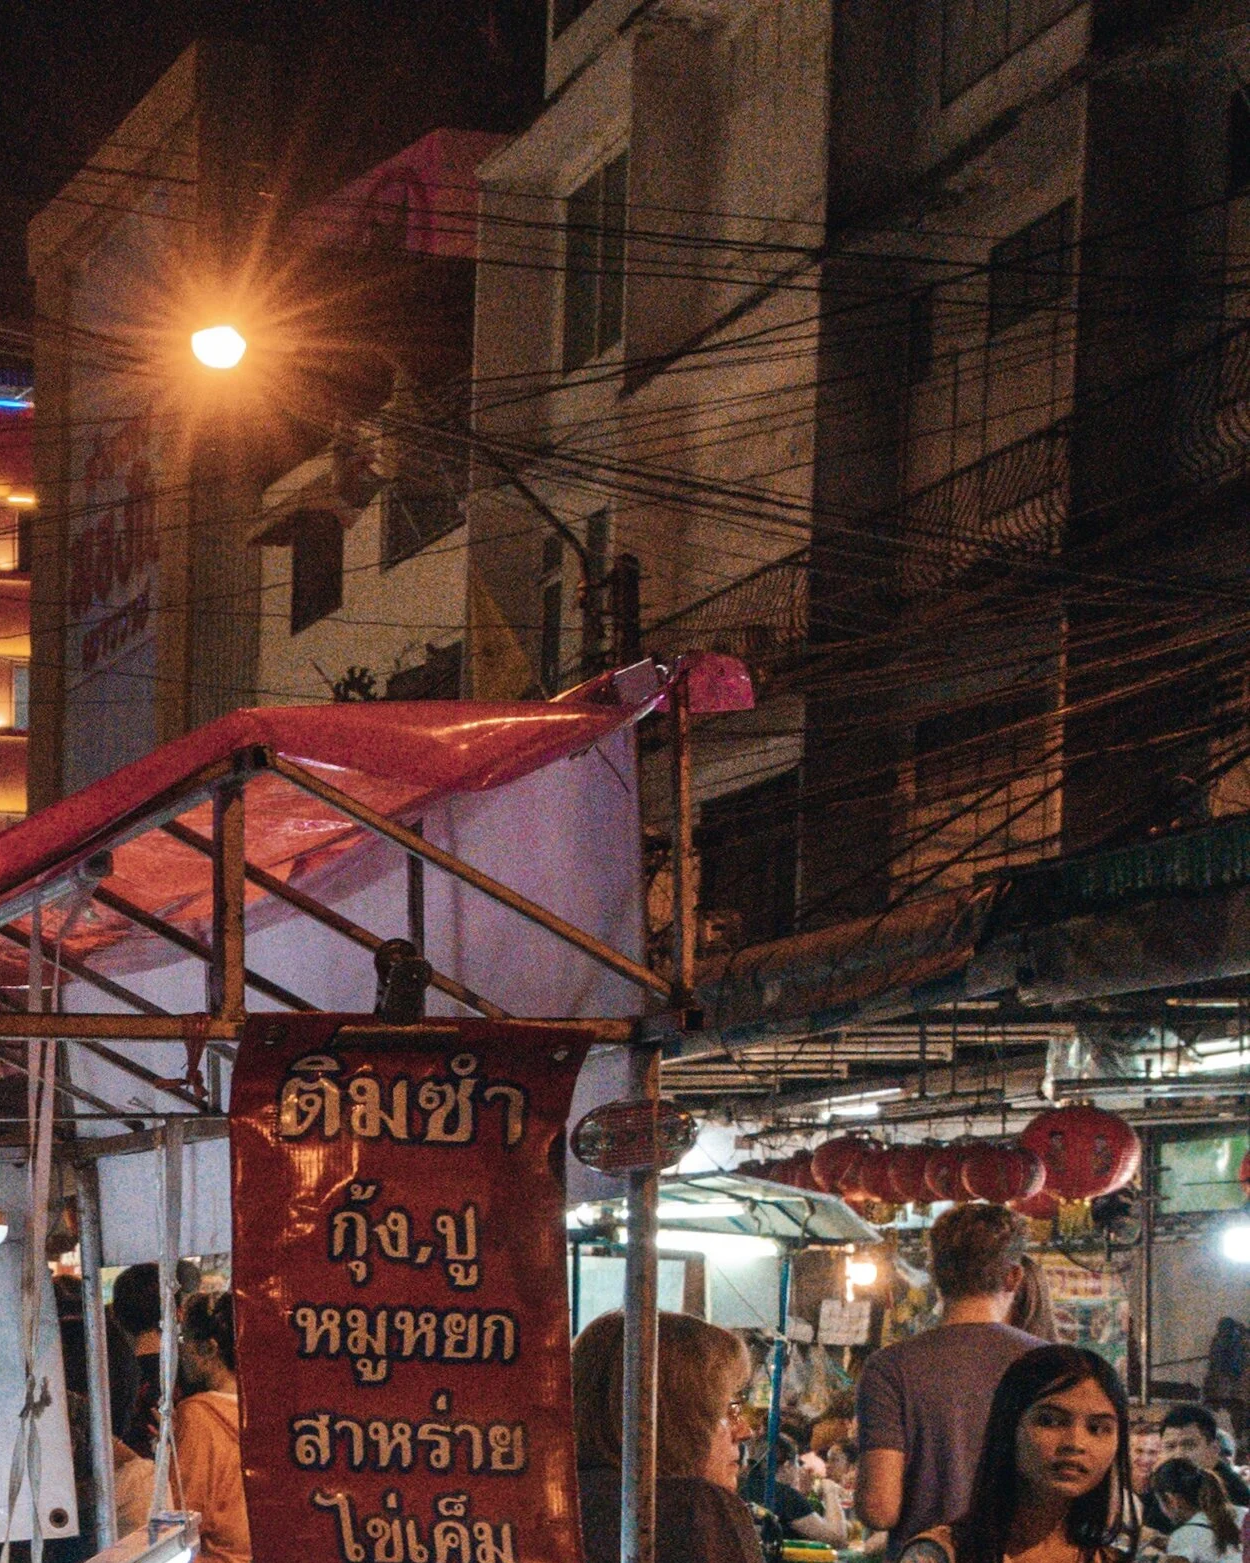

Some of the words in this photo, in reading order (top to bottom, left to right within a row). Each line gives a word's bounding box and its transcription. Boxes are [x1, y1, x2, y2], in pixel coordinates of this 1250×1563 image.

[330, 1183, 480, 1286] กุ้ง,ปู
[295, 1307, 516, 1382] หมูหยก
[292, 1394, 525, 1471] สาหร่าย
